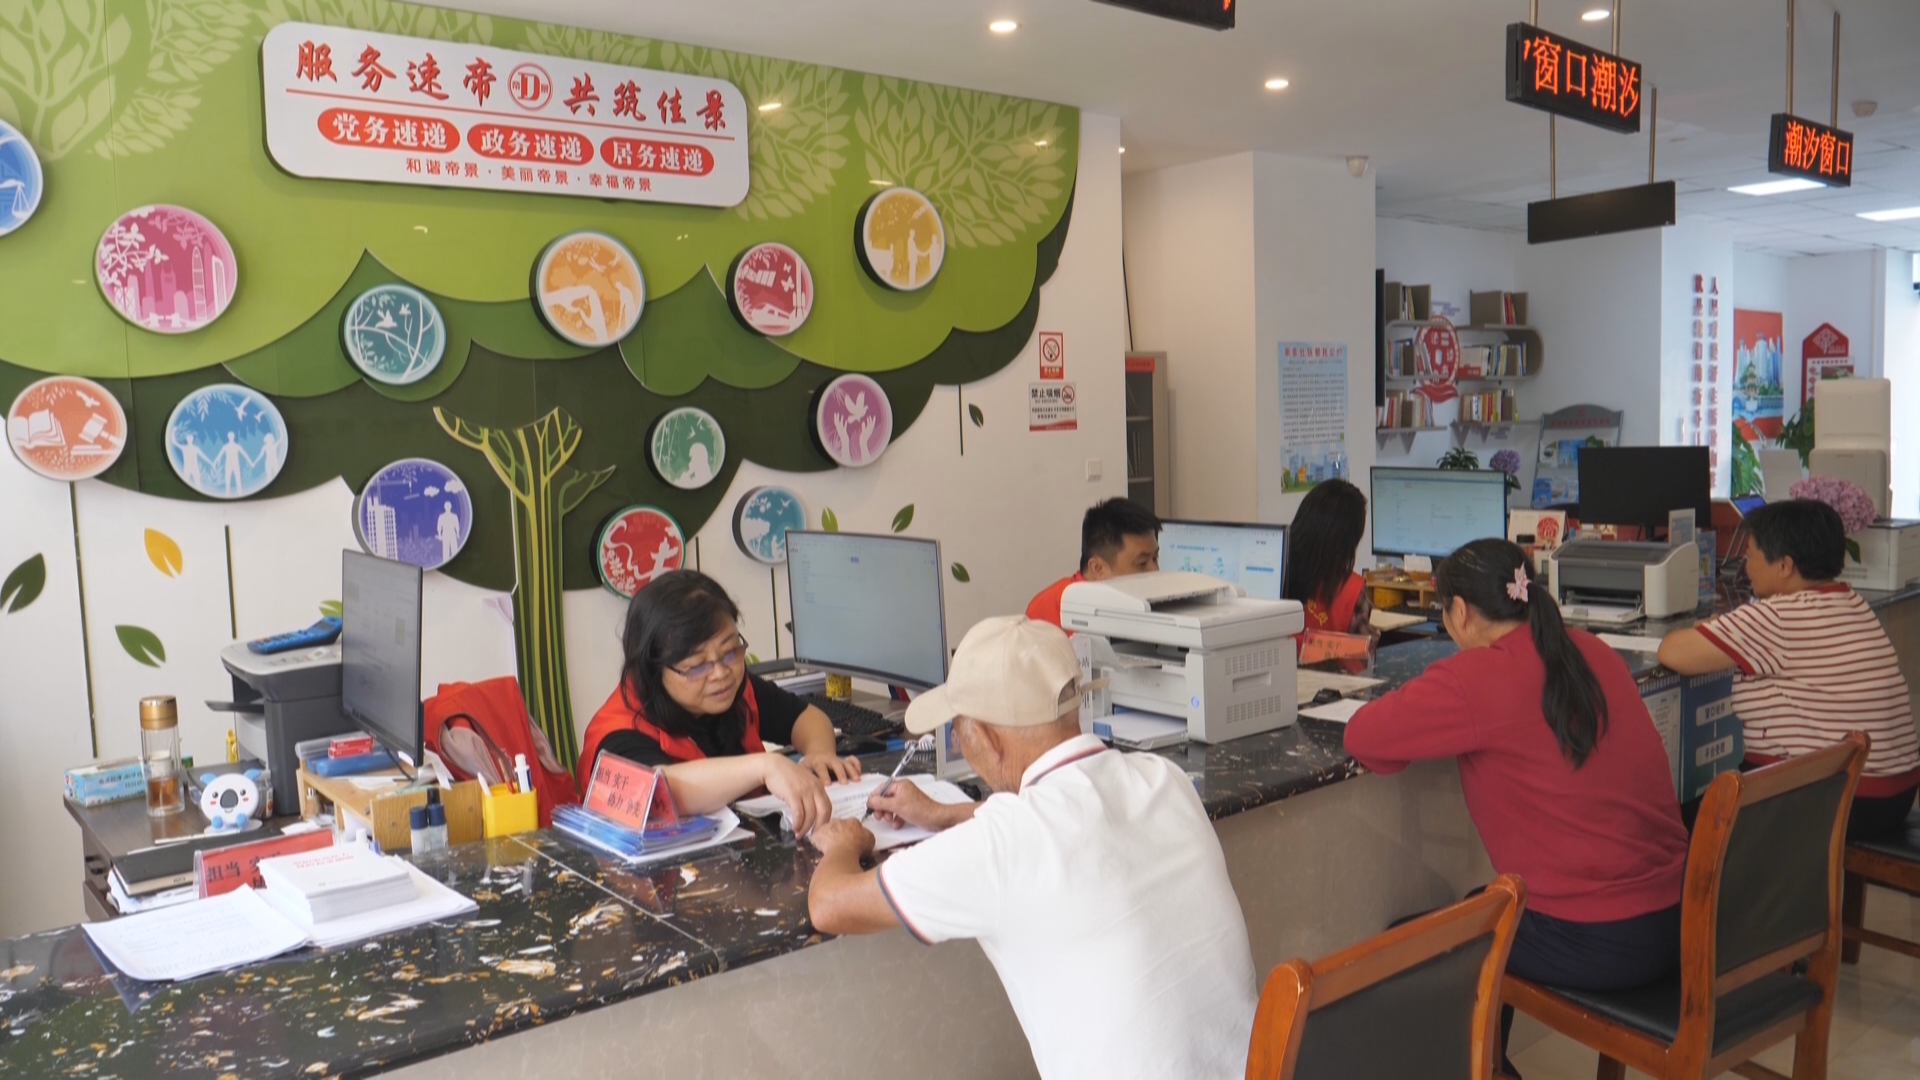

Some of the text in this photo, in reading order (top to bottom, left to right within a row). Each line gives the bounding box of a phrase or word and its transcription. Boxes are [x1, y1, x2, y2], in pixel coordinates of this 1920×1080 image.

[296, 40, 497, 106] 服务速帝
[563, 72, 727, 130] 共筑佳景
[1524, 36, 1639, 117] 窗口潮汐
[332, 112, 704, 172] 党务速递 政务速递 居务速递
[1784, 120, 1850, 176] 潮汐窗口
[1031, 387, 1061, 399] 禁止吸烟
[207, 860, 241, 883] 担当
